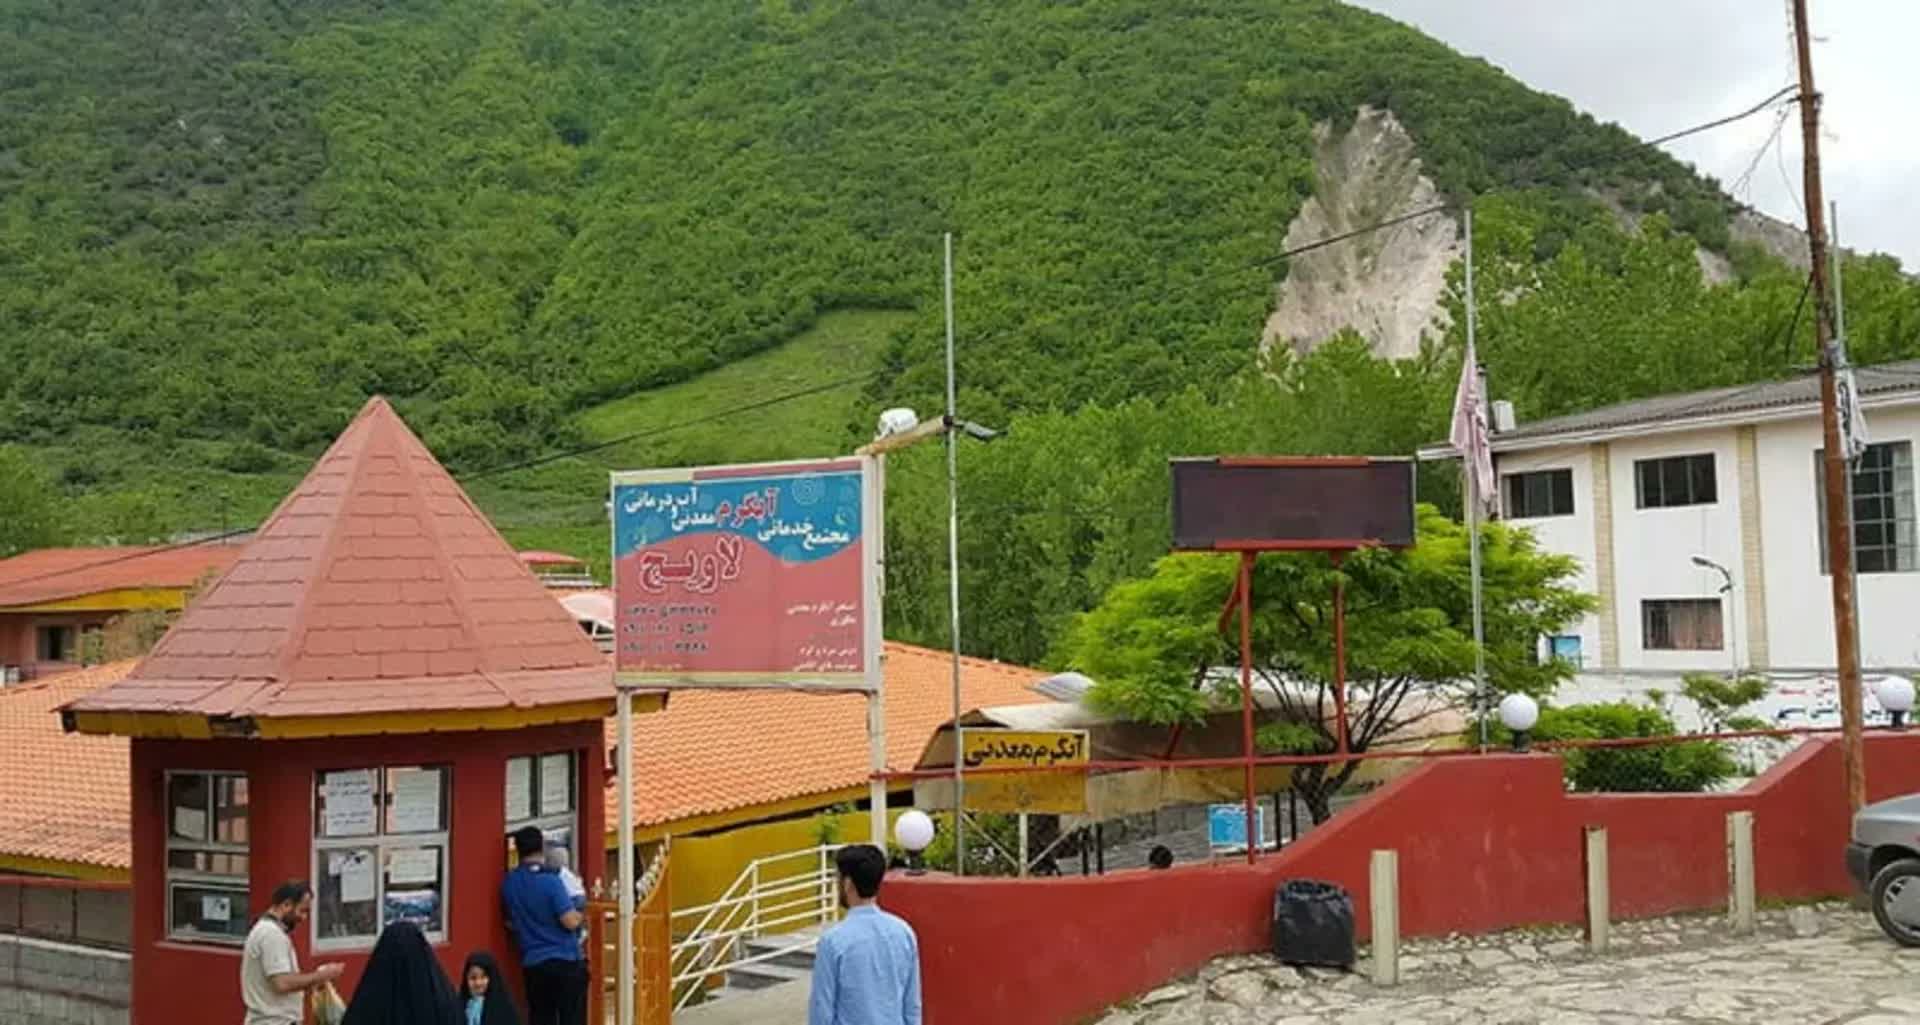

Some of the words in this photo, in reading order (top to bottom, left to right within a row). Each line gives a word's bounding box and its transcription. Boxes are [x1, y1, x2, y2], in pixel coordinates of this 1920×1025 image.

[624, 490, 673, 513] درمانی
[715, 487, 780, 529] آبگرم
[671, 511, 716, 532] معدنی
[757, 517, 813, 541] خدماتی
[803, 528, 850, 550] مجتمع
[639, 535, 744, 593] لاویج
[963, 737, 1032, 767] معدنی
[1032, 733, 1085, 766] آبگرم
